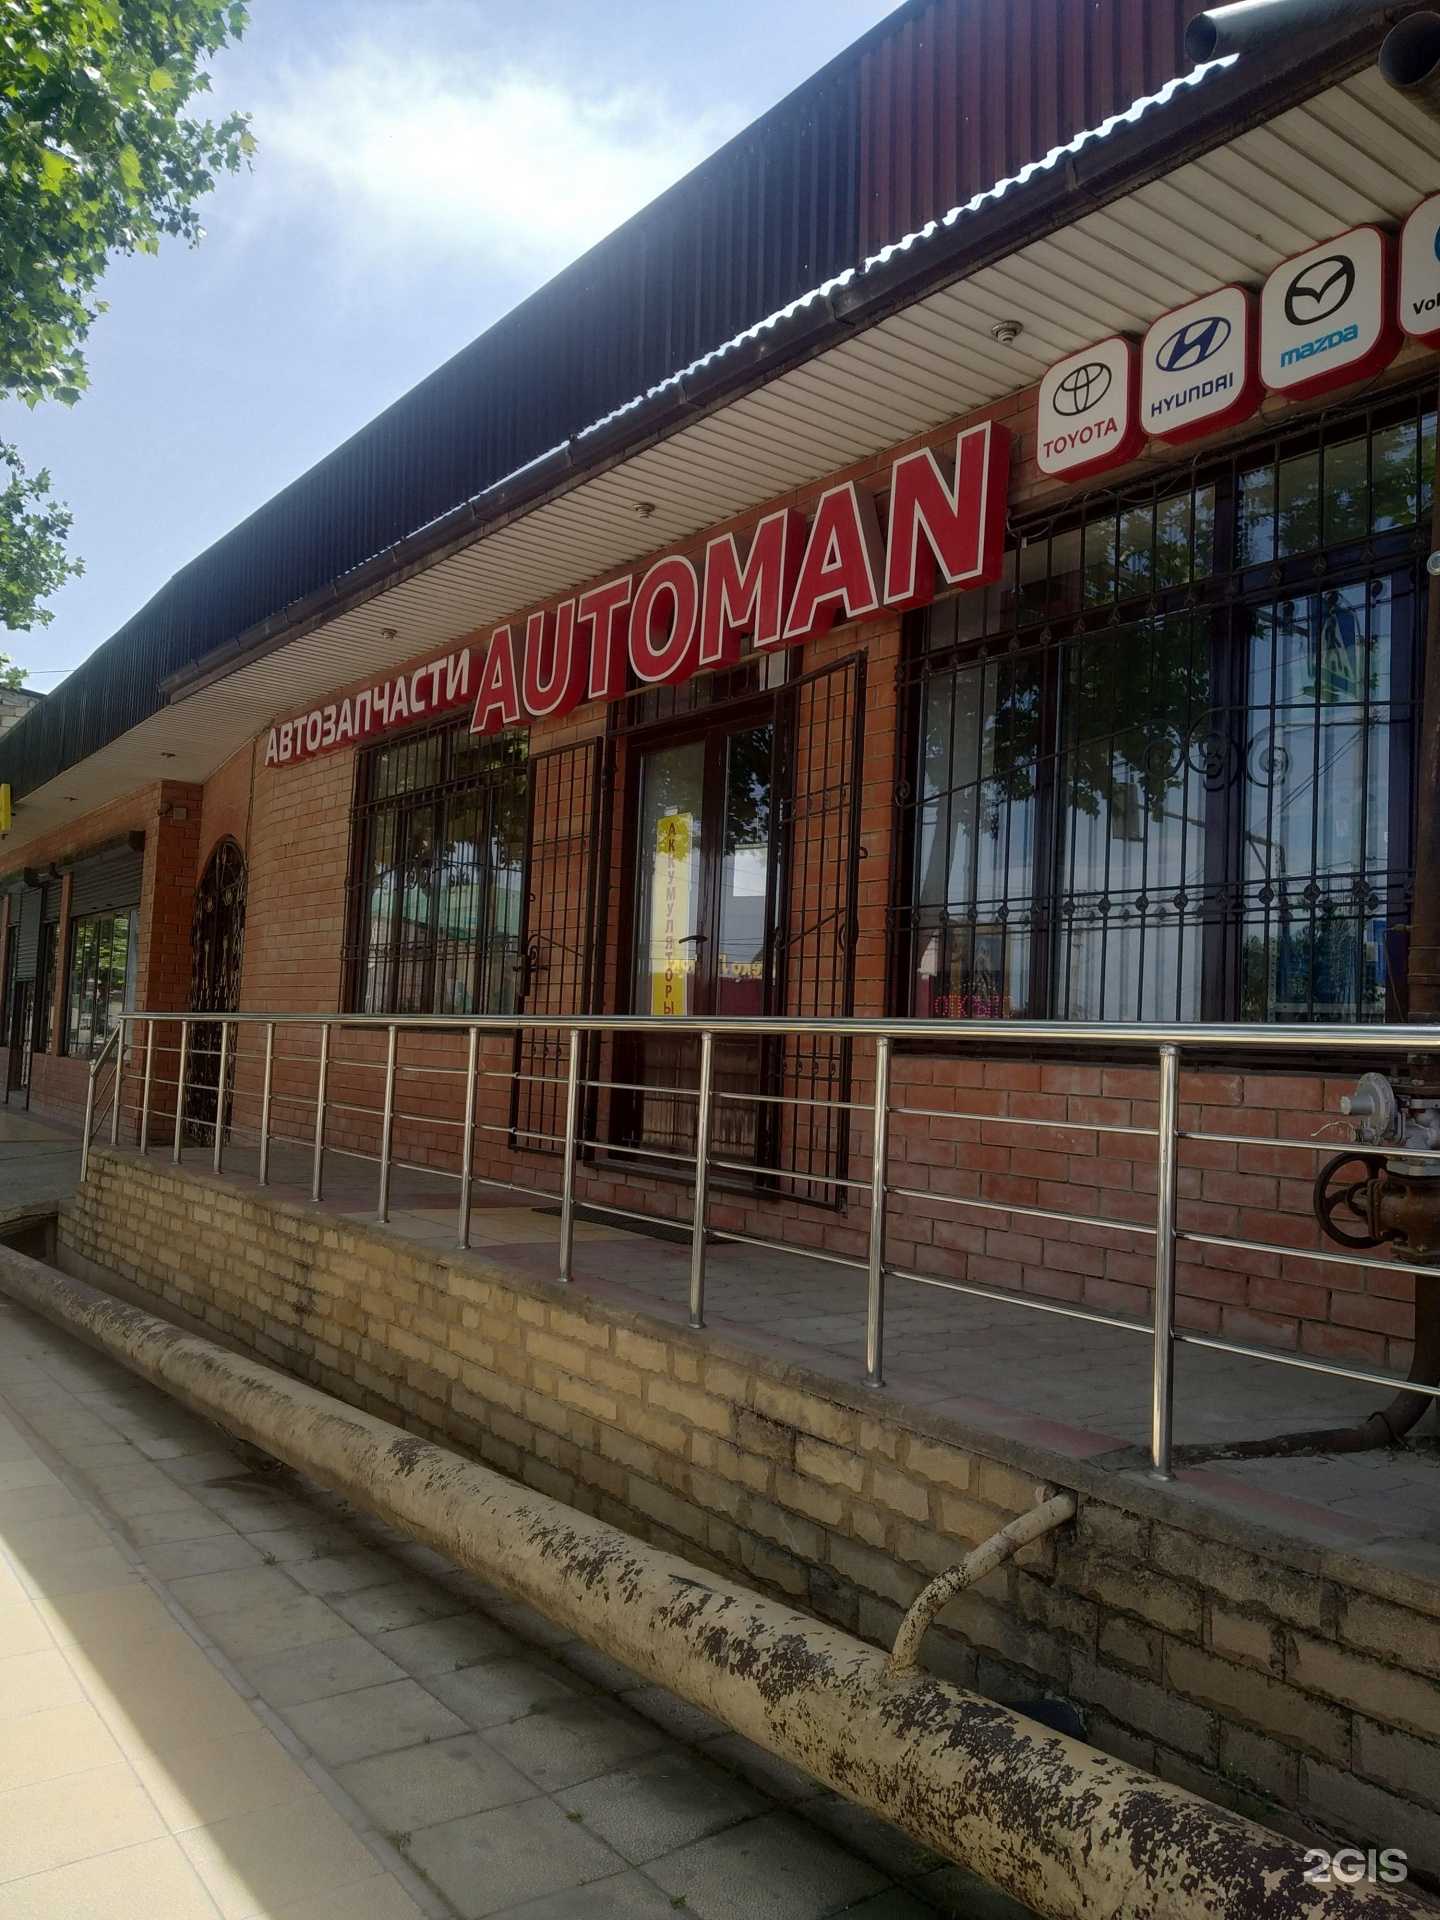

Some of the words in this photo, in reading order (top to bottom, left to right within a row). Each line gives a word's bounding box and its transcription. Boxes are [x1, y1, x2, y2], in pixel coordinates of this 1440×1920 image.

[1280, 323, 1359, 368] mazda
[1151, 372, 1234, 418] HYUNDAI
[1043, 416, 1118, 459] TOYOTA
[469, 419, 993, 735] AUTOMAN
[263, 650, 470, 767] АВТОЗАПЧАСТИ
[663, 821, 676, 1015] АККУМУЛЯТОРЫ
